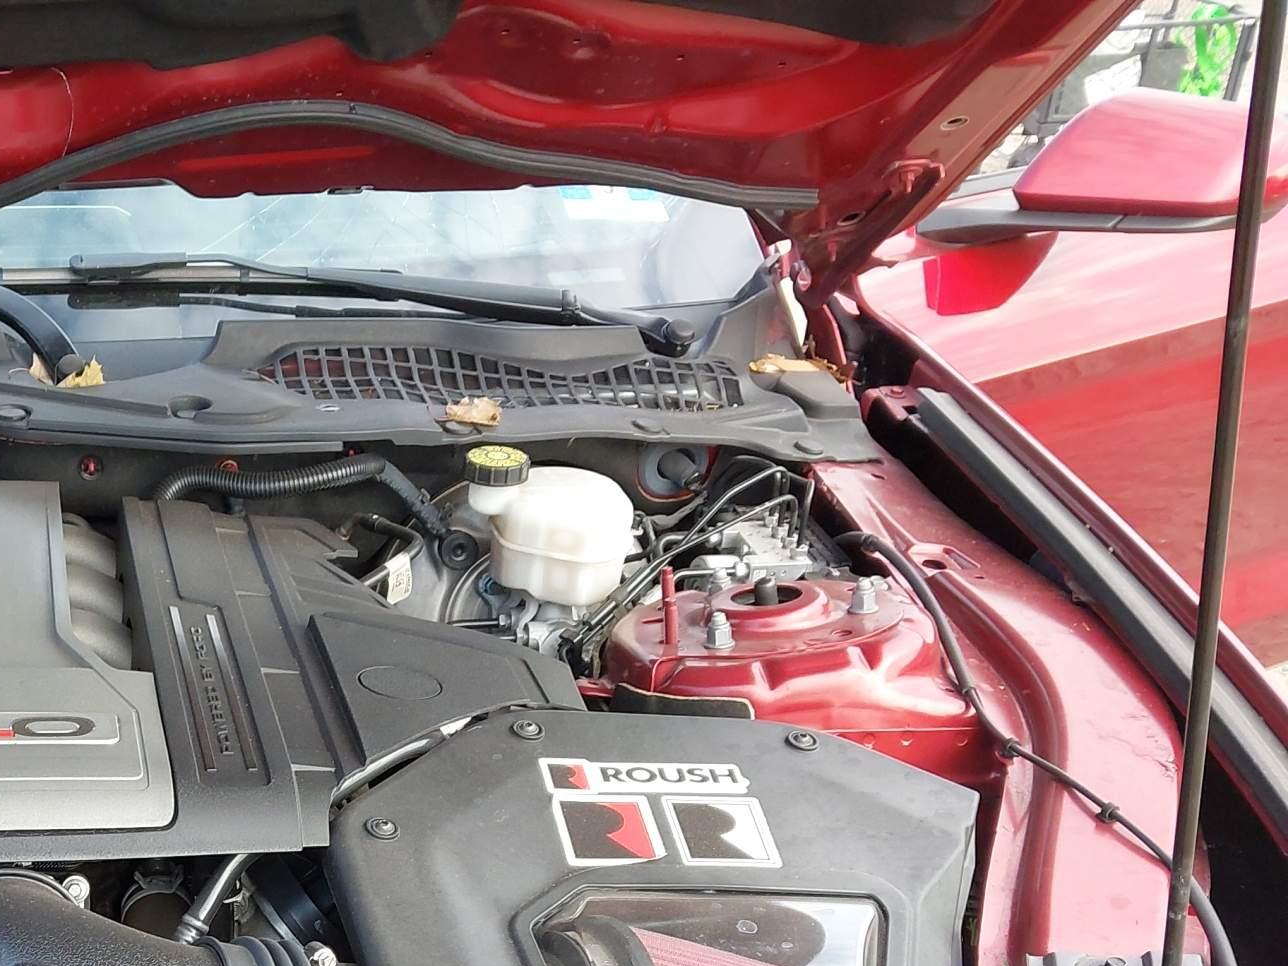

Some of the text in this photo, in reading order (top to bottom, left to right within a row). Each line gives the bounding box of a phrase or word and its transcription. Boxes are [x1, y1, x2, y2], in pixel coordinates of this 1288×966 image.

[190, 626, 235, 755] POWERED BY FORD
[600, 766, 739, 784] ROUSH
